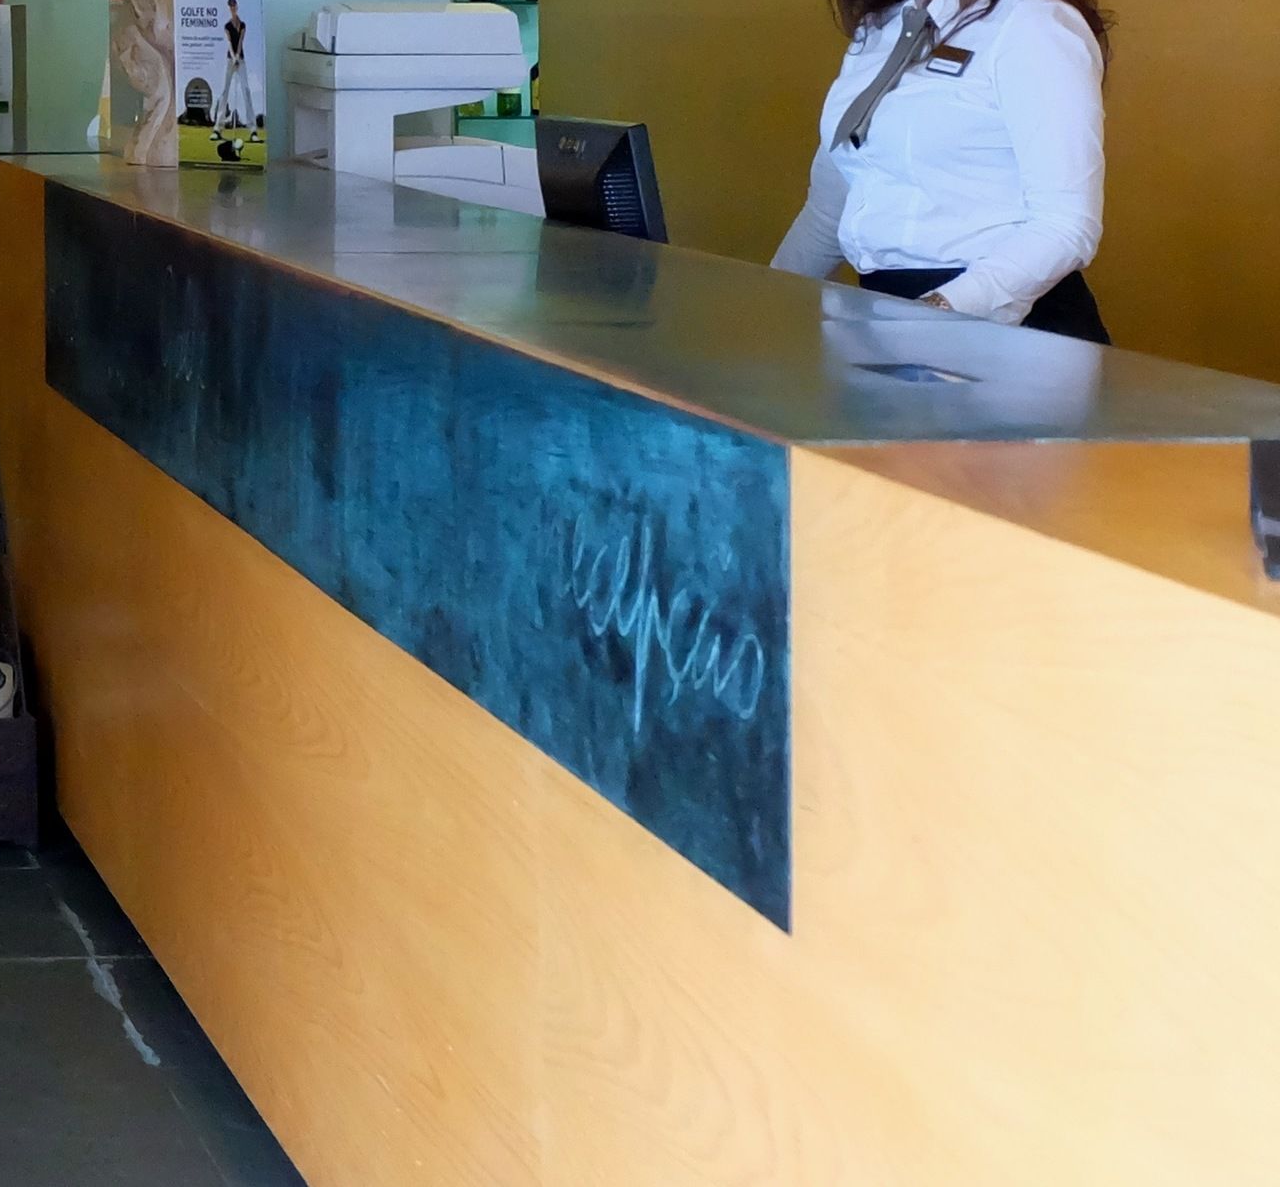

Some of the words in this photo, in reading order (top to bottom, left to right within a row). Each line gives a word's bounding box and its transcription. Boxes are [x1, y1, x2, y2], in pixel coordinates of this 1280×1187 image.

[181, 7, 204, 16] GOLFE
[206, 7, 217, 16] NO
[181, 18, 217, 27] FEMININO
